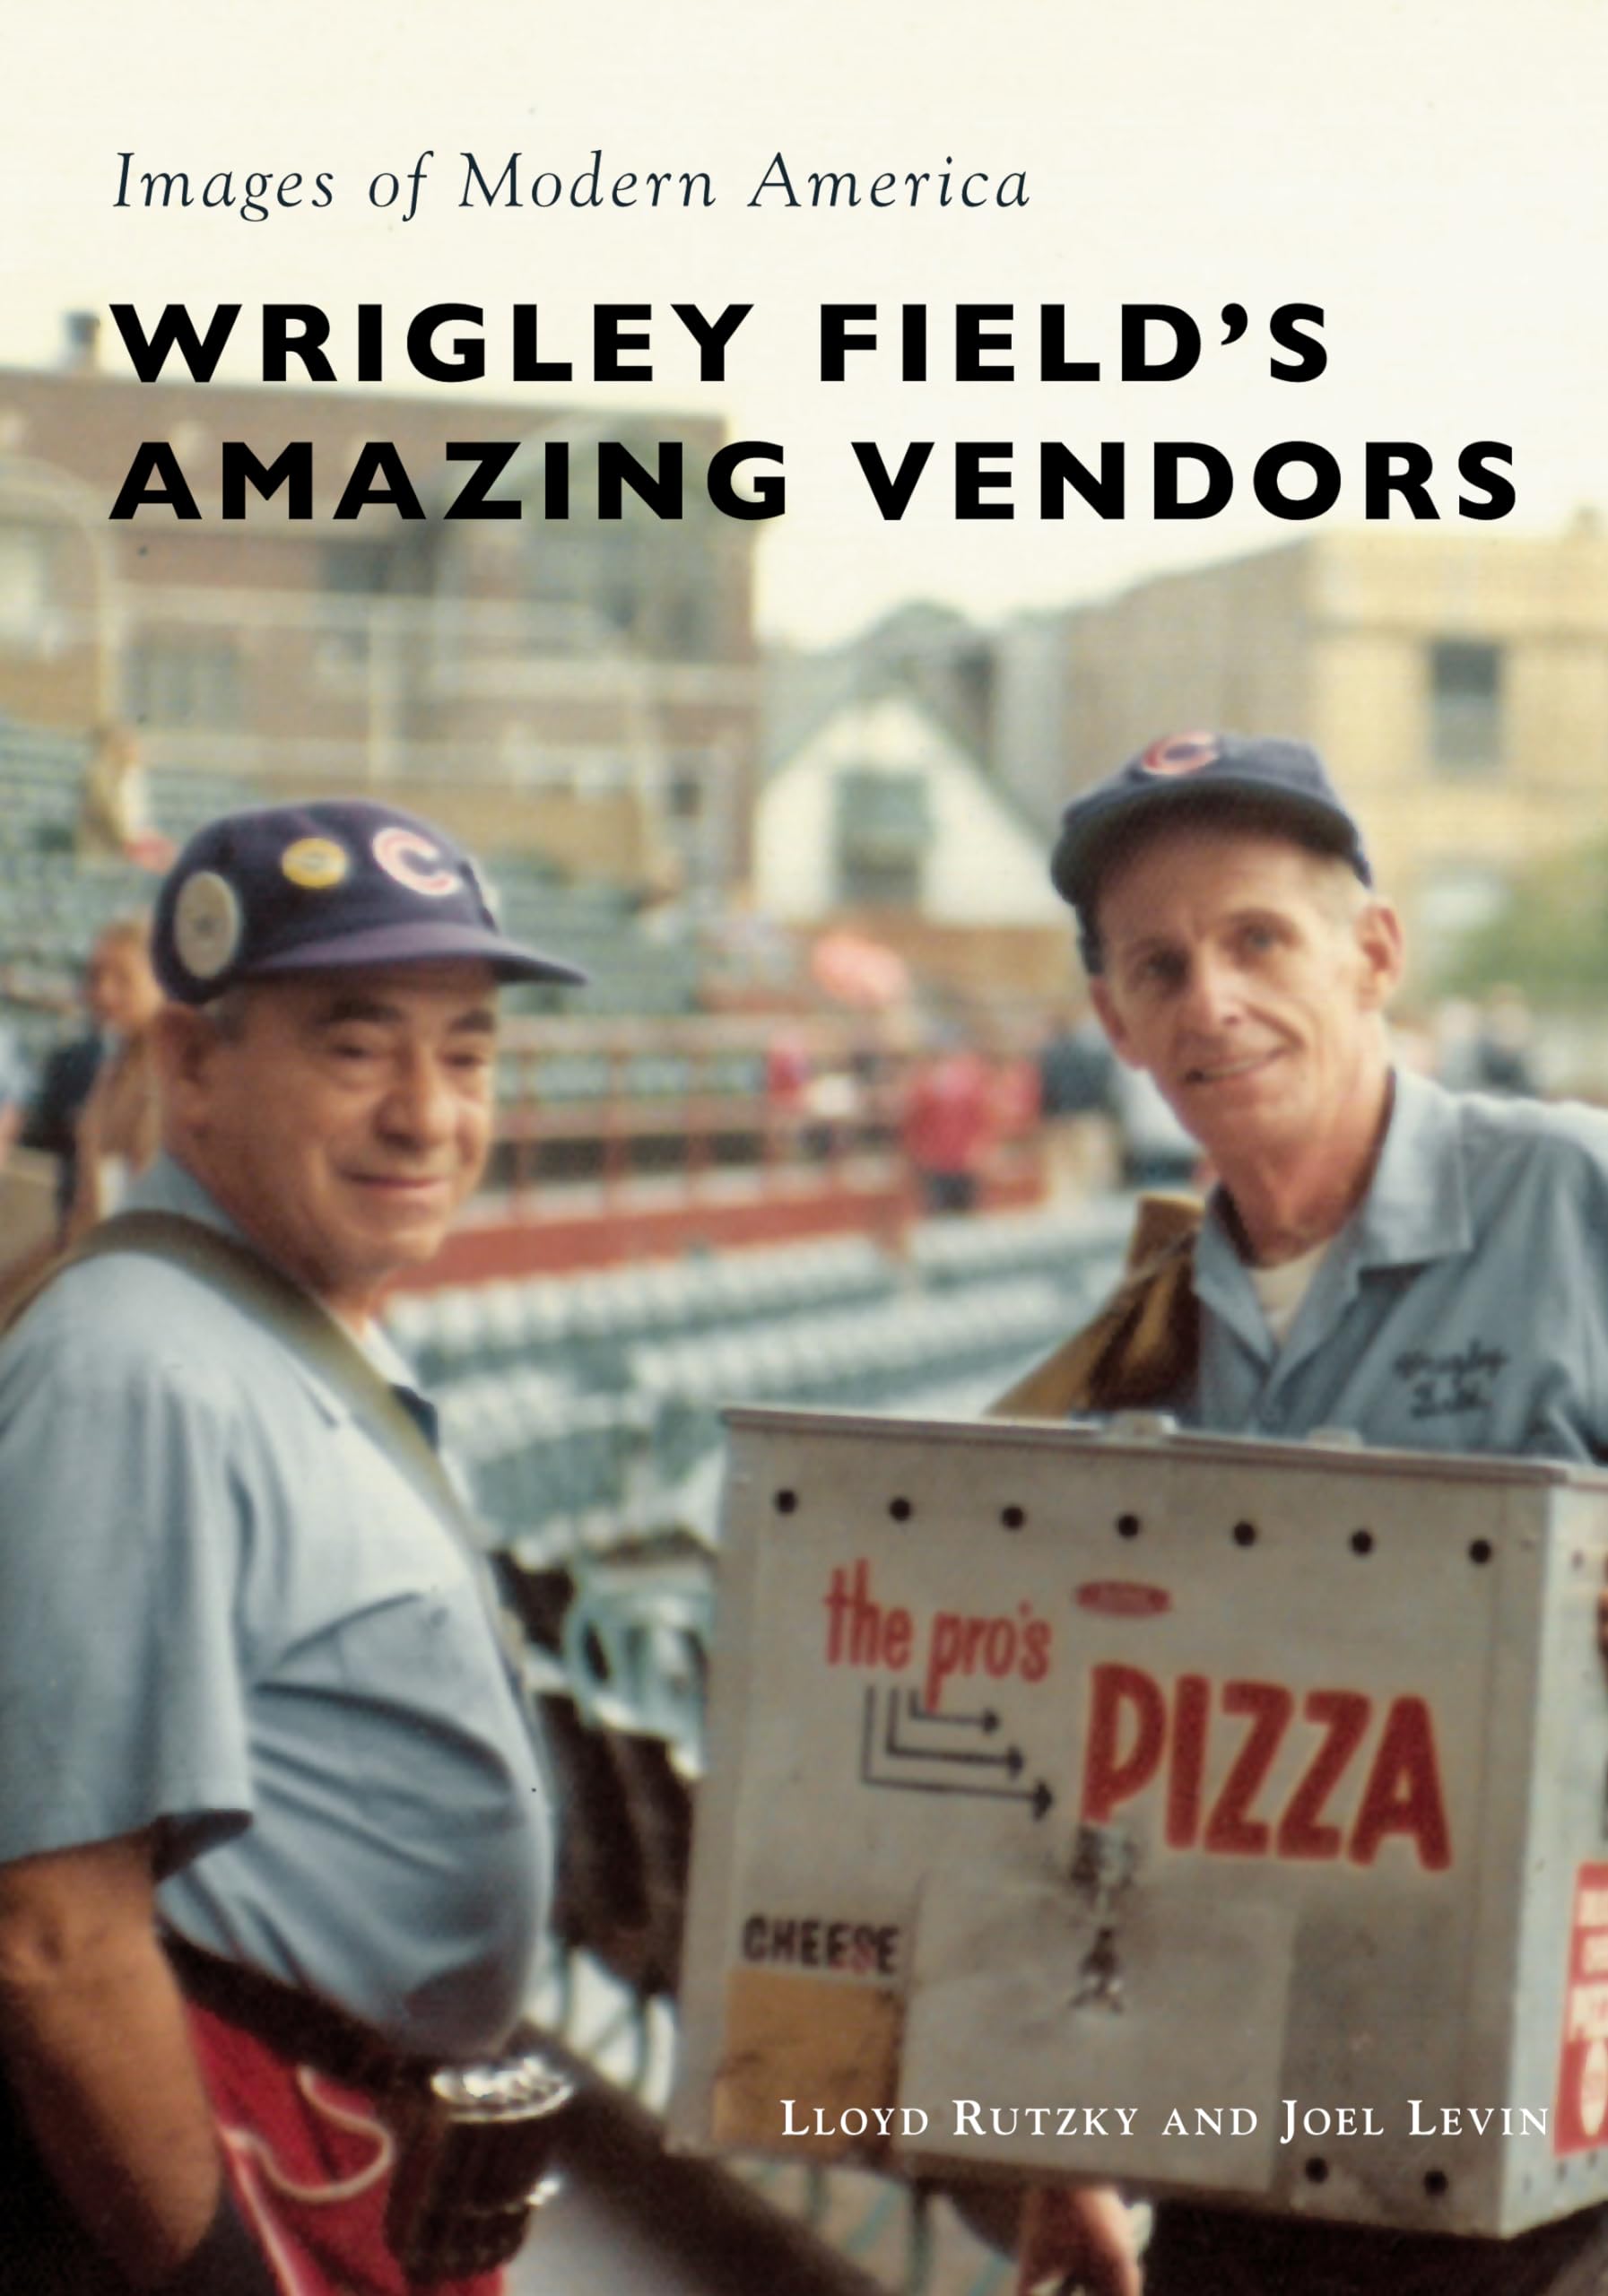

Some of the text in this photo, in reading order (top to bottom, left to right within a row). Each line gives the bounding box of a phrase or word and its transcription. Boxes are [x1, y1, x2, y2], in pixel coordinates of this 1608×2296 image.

[371, 825, 463, 897] C
[822, 1558, 1053, 1713] the pro's
[1079, 1661, 1454, 1874] PIZZA
[742, 1916, 900, 1976] CHEESE
